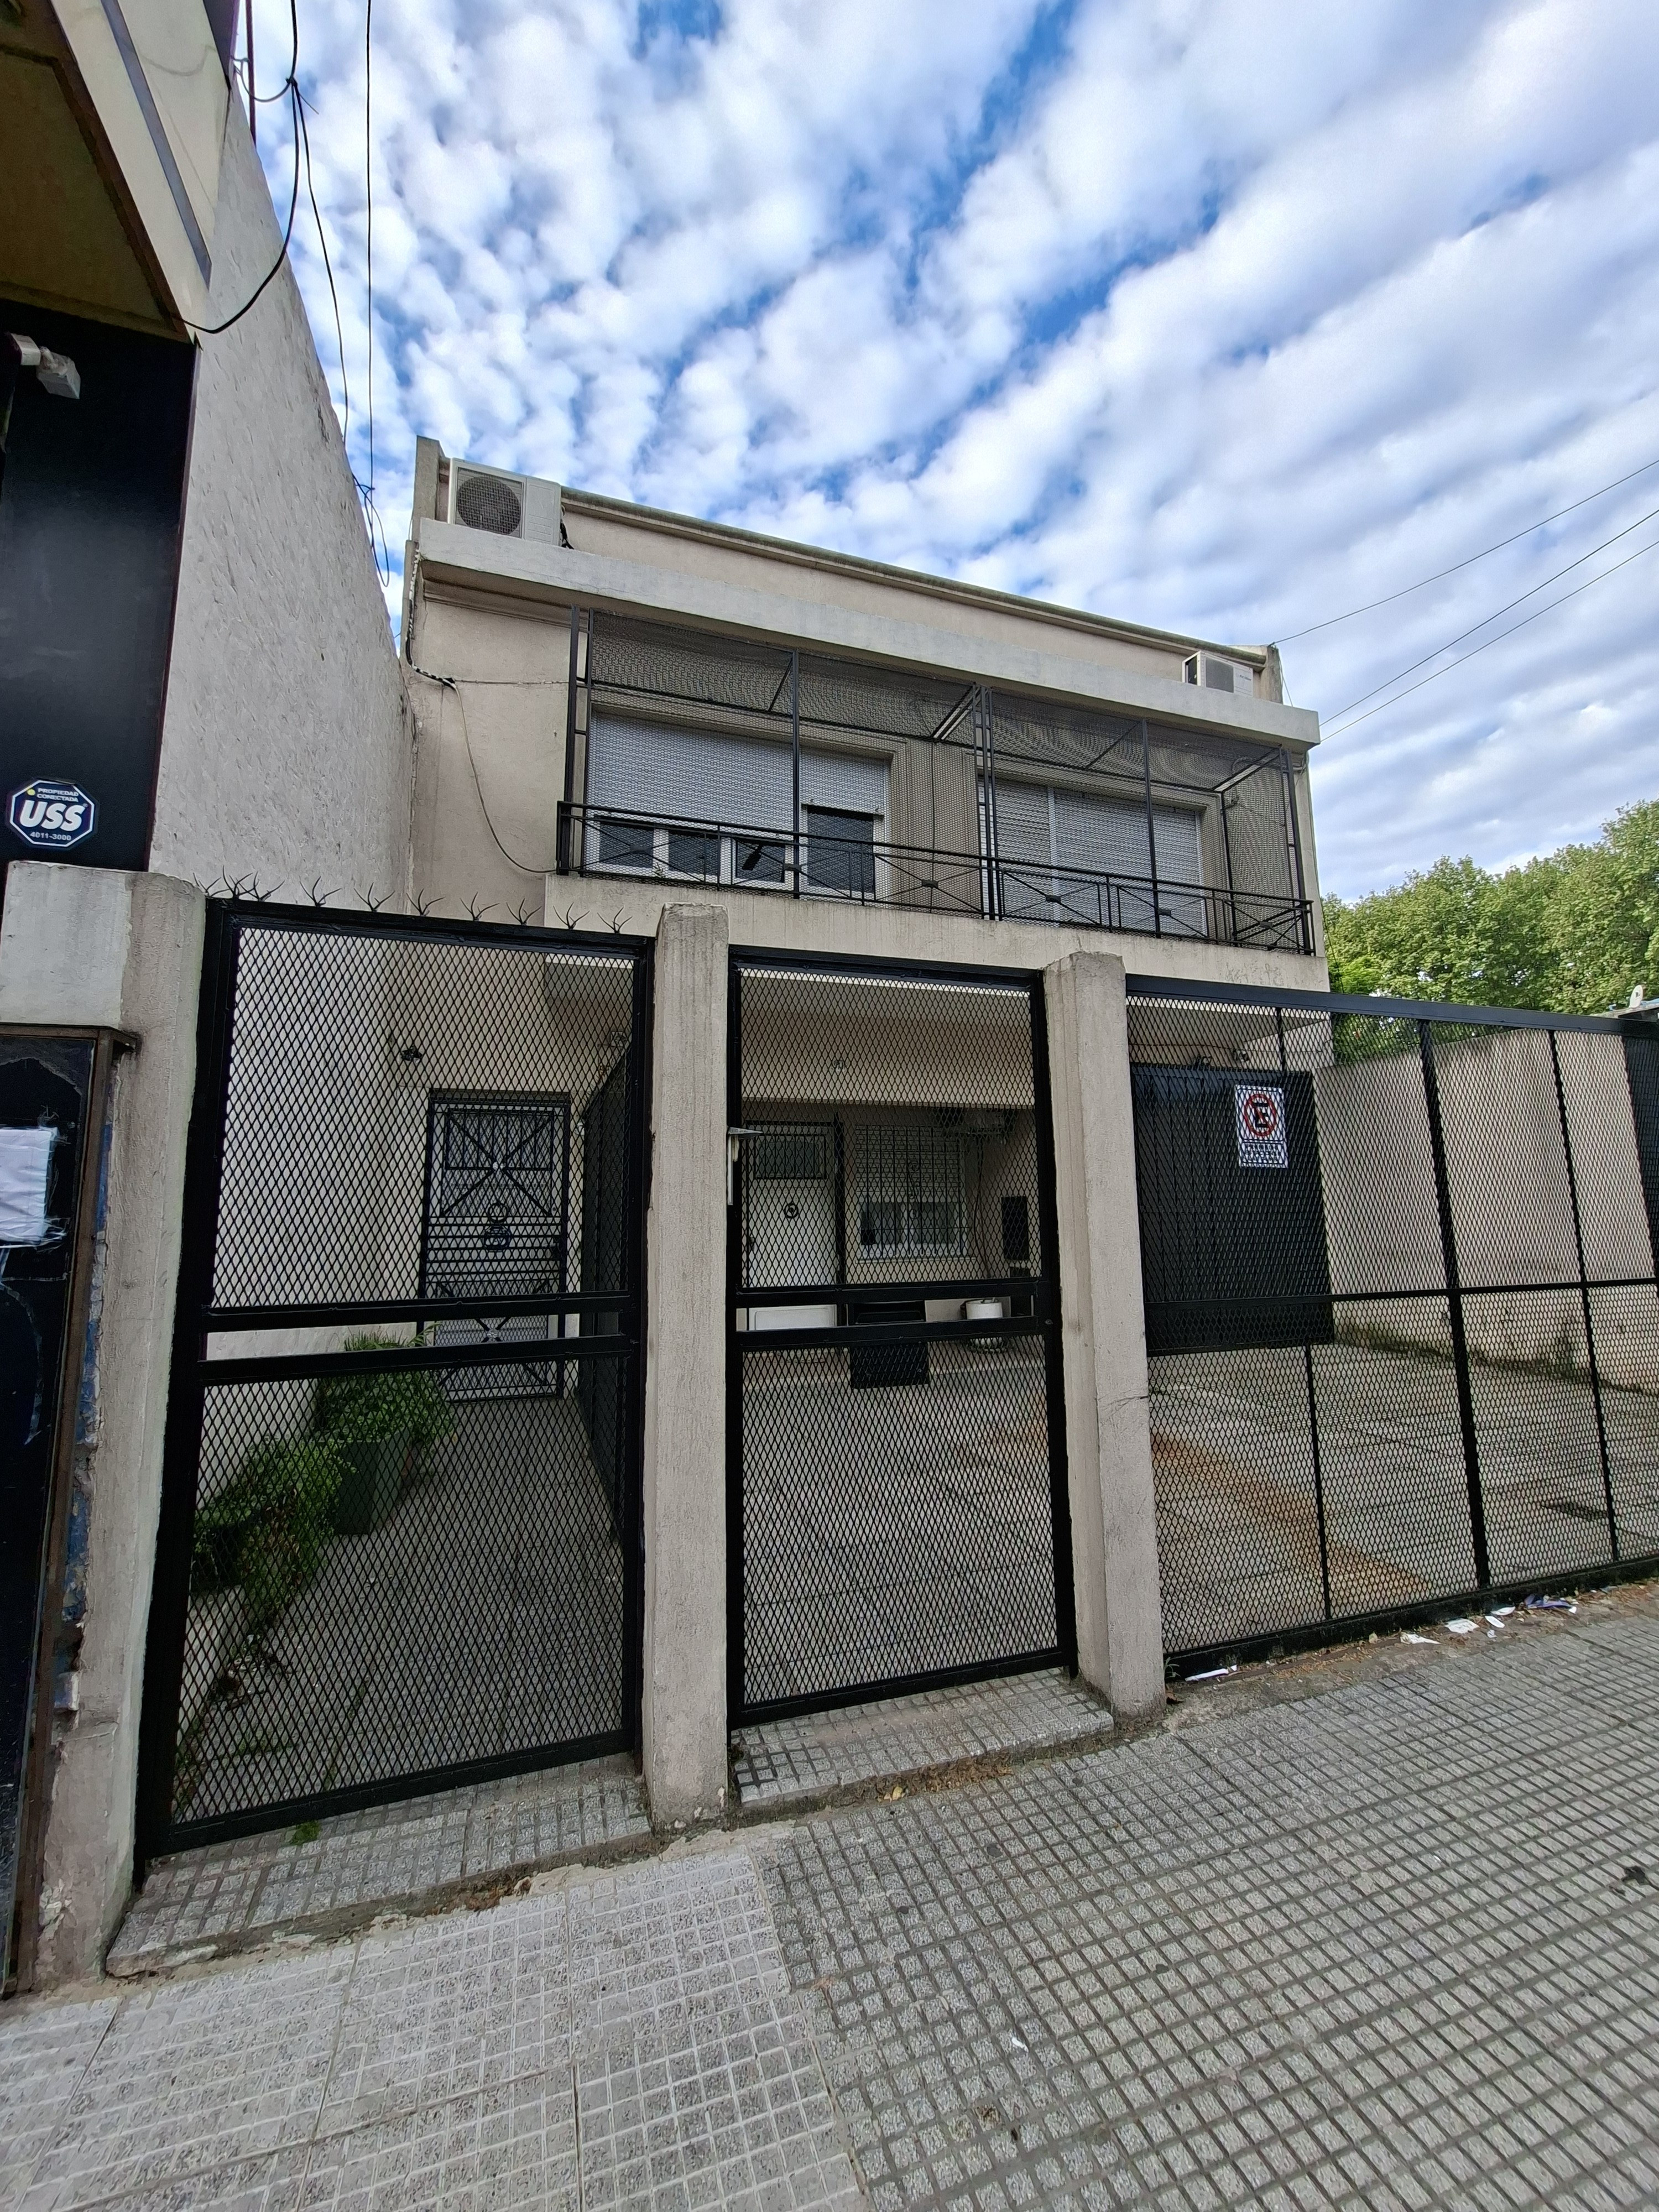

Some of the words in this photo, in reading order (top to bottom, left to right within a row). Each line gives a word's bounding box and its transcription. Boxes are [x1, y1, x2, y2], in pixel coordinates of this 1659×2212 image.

[38, 788, 79, 797] PROPIEDAD
[36, 794, 79, 802] CONECTADA
[19, 800, 86, 831] USS
[30, 832, 71, 841] 4011-3000
